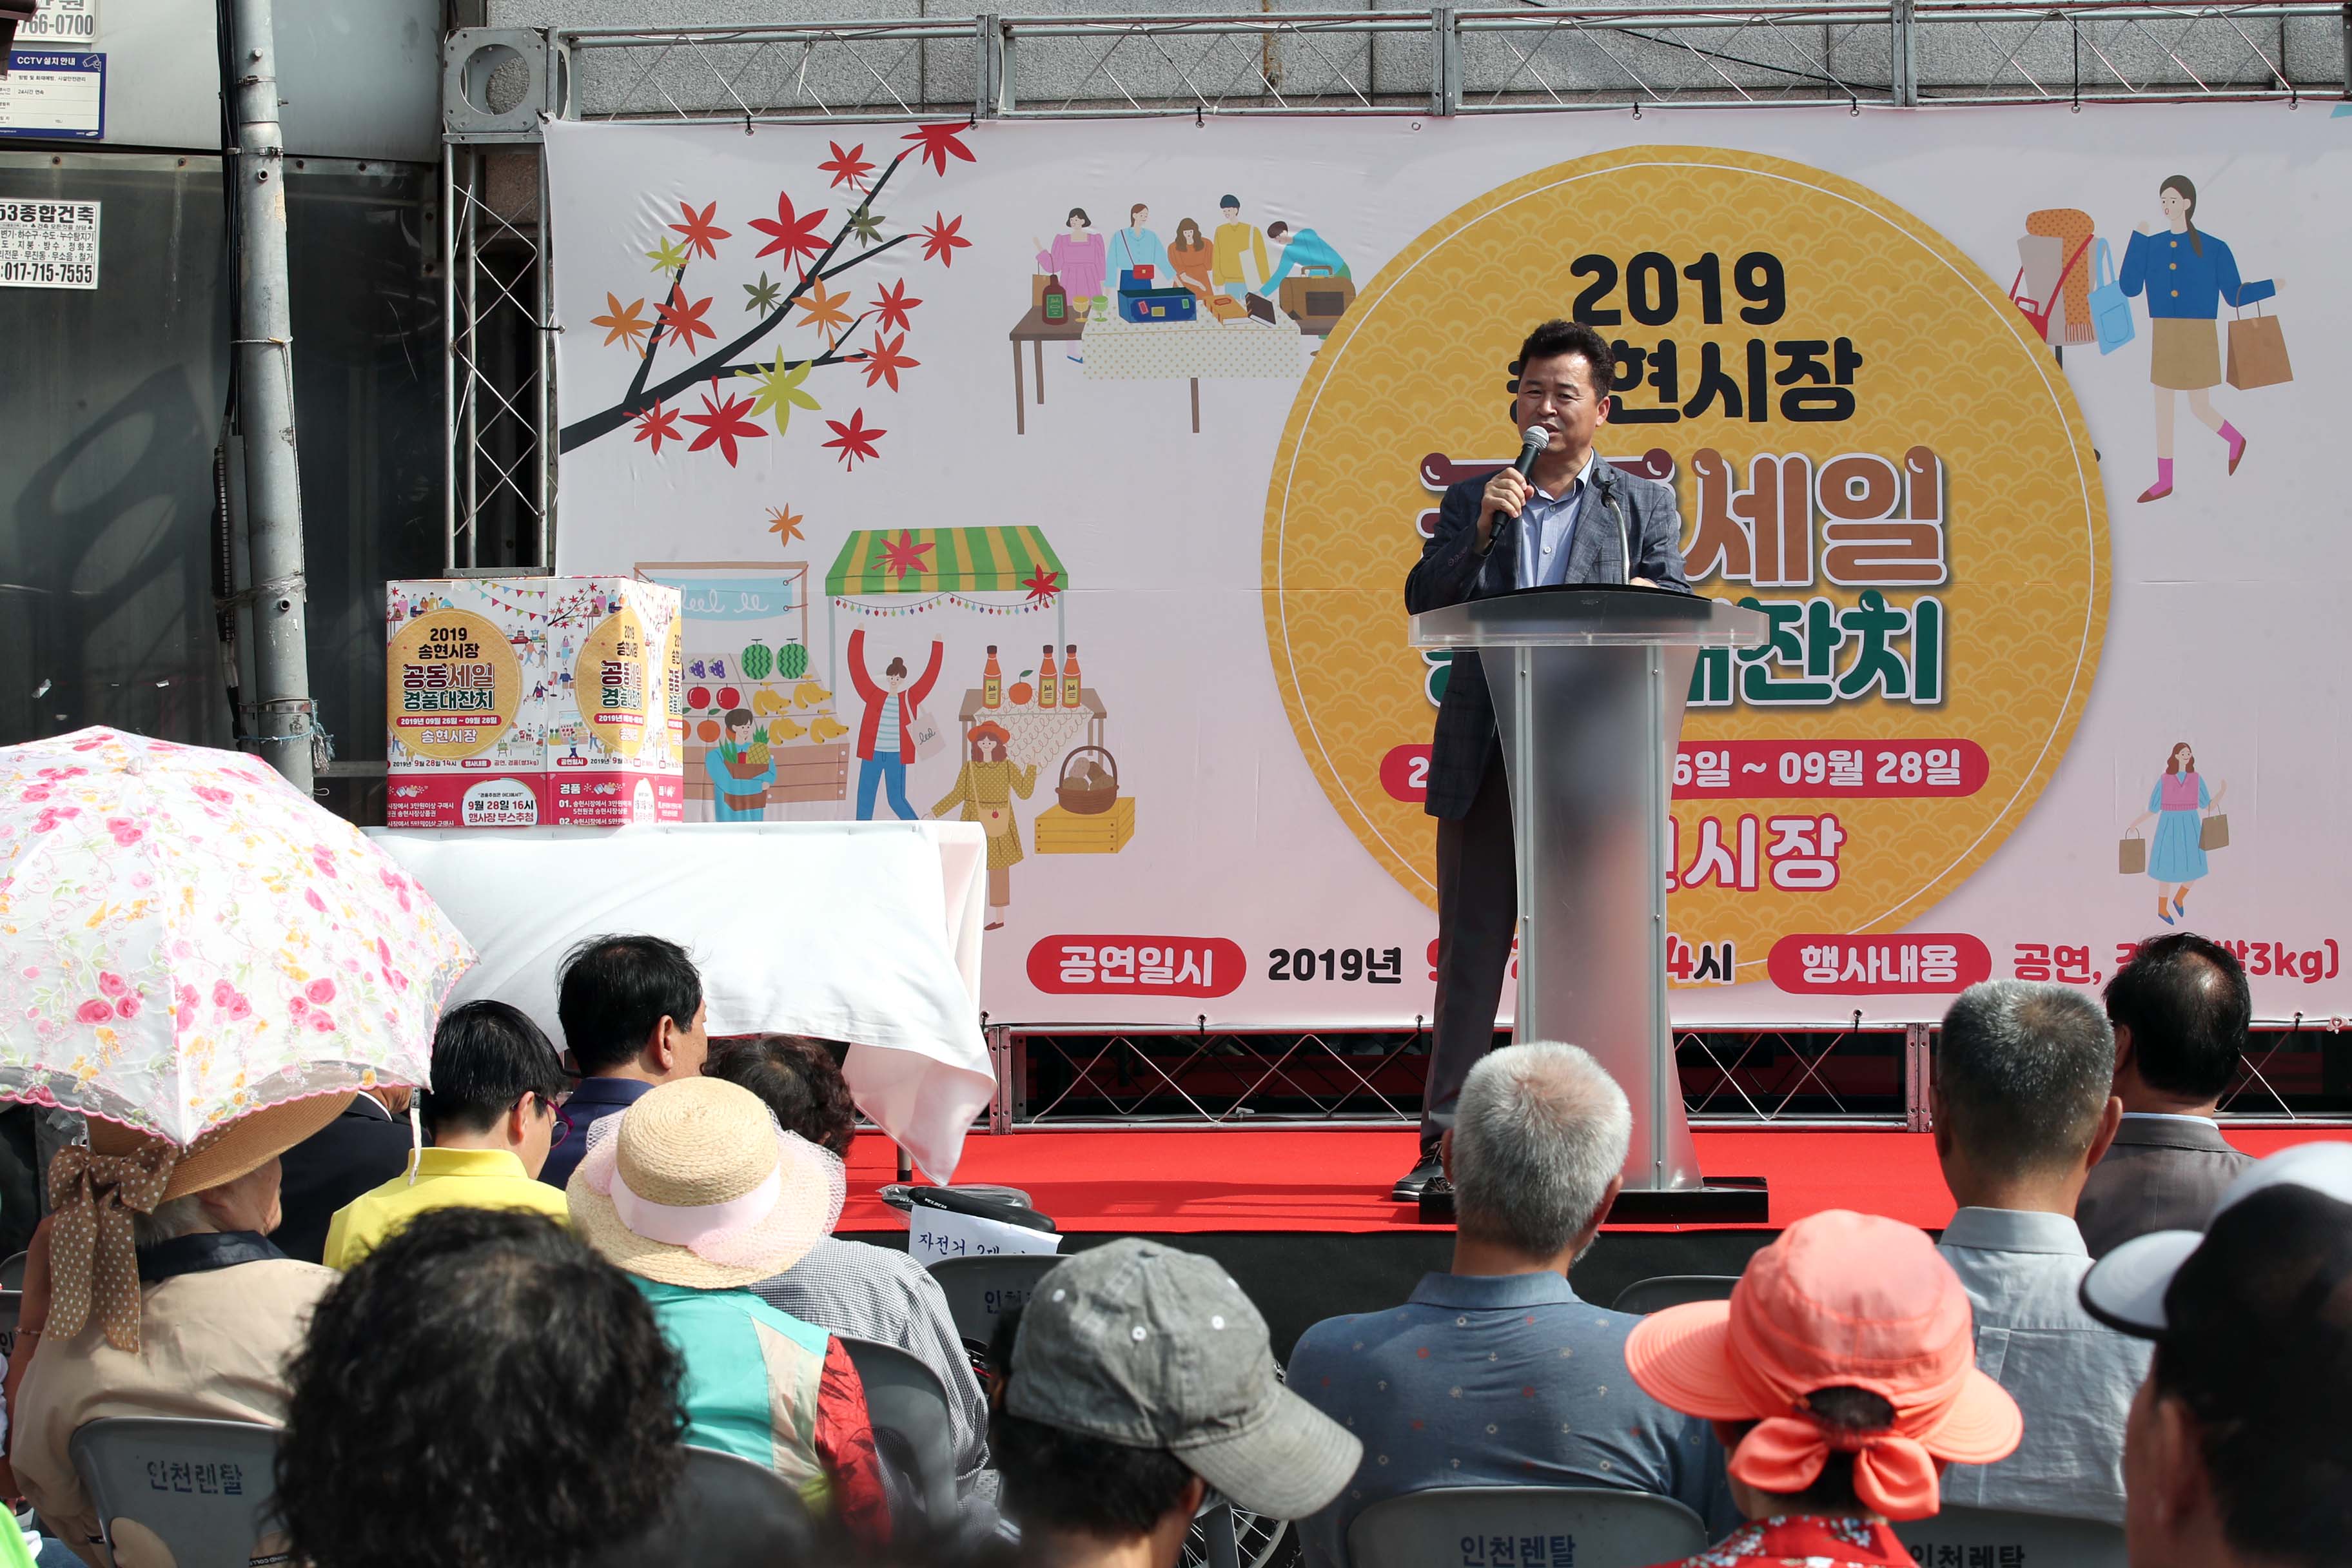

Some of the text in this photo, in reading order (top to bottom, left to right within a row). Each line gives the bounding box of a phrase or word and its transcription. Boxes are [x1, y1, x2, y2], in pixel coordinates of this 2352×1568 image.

[1569, 251, 1786, 326] 2019
[1507, 337, 1863, 425] 현시장
[430, 627, 467, 642] 2019
[418, 643, 480, 660] 송현시장
[403, 662, 495, 690] 공동세일
[404, 689, 495, 712] 경품대잔치
[401, 717, 424, 725] 2019년
[598, 714, 622, 722] 2019년
[421, 729, 477, 743] 송현시장
[1672, 750, 1730, 787] 6일
[1778, 750, 1863, 788] 09월
[1876, 748, 1961, 787] 28일
[560, 783, 580, 795] 경품
[468, 800, 534, 810] 9월 28일 16시
[558, 799, 572, 808] 01.
[469, 812, 496, 823] 행사장
[1666, 812, 1847, 894] 시장
[1059, 944, 1213, 986] 공연일시
[1268, 946, 1402, 985] 2019년
[1666, 936, 1734, 981] 4시
[1800, 944, 1958, 985] 행사내용
[2014, 943, 2101, 986] 공연,
[918, 1231, 965, 1256] 자전거
[147, 1460, 243, 1495] 인천렌탈
[1460, 1534, 1575, 1567] 인천렌탈
